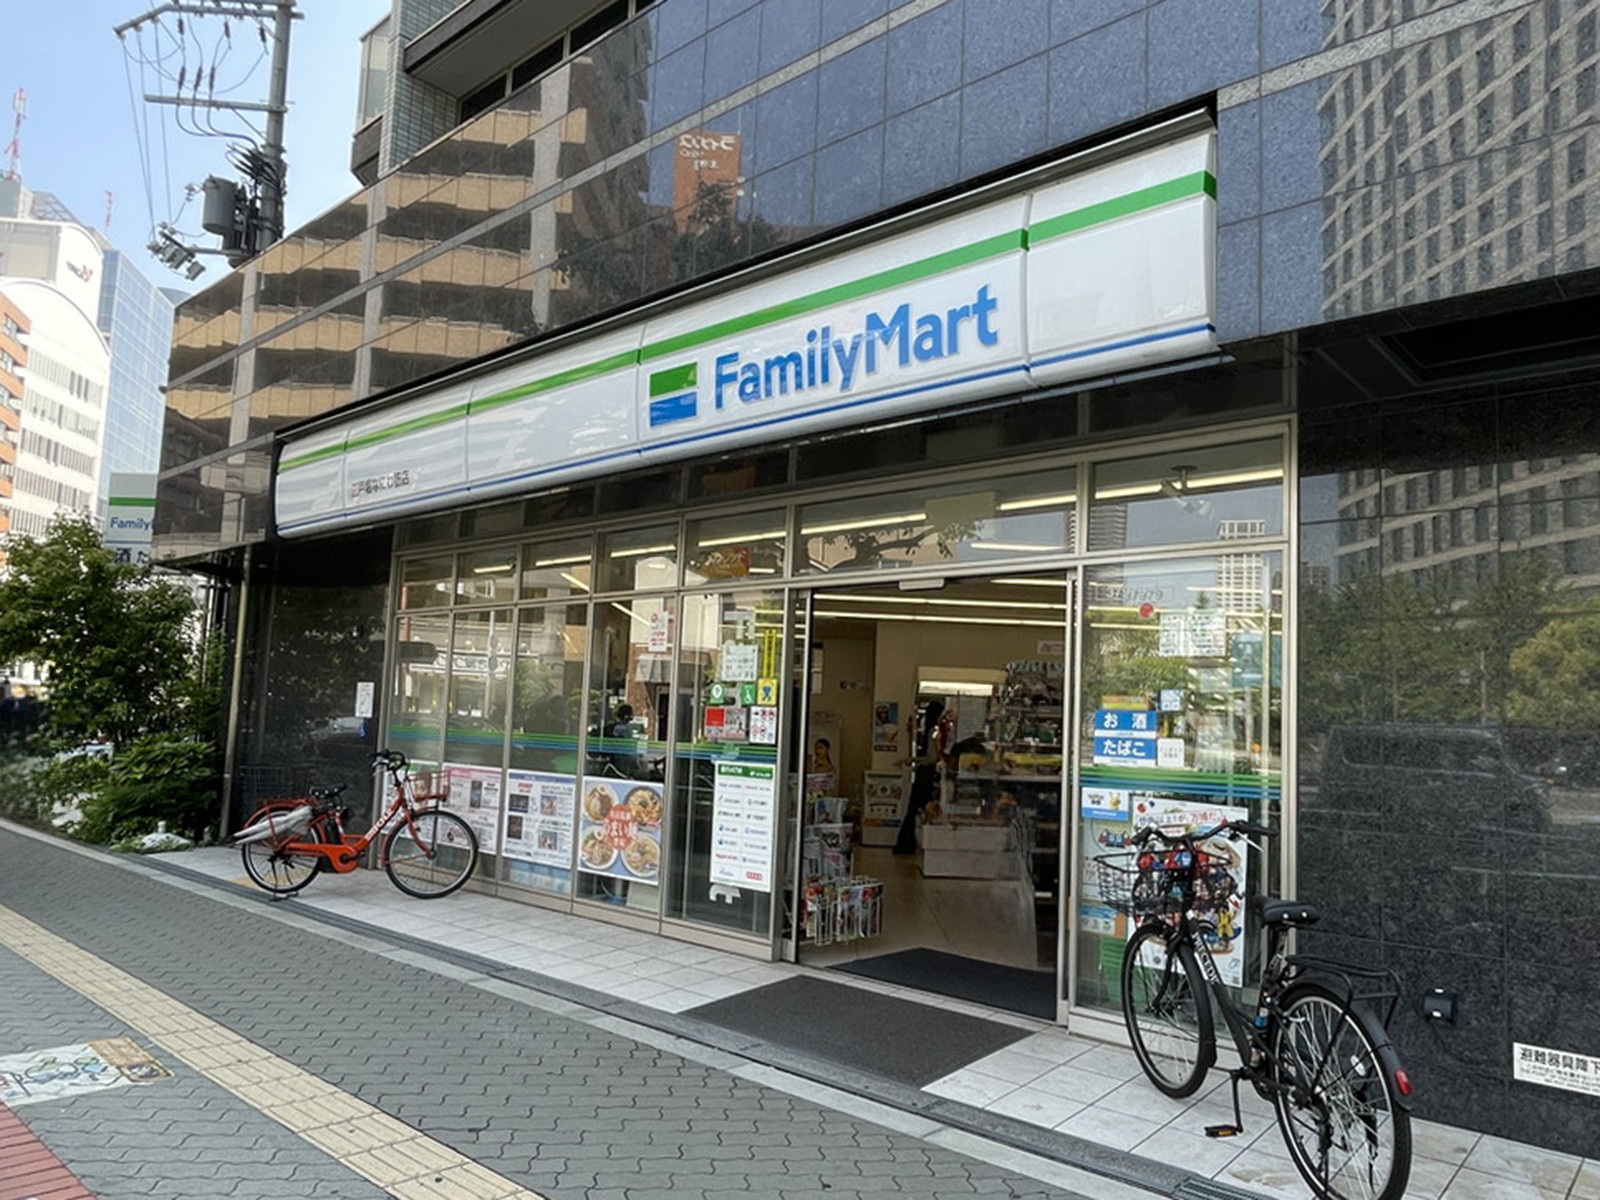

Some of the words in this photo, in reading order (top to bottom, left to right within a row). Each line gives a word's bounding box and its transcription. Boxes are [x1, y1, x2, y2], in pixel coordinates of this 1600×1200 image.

[714, 283, 998, 410] FamilyMart
[110, 516, 152, 531] Family
[1103, 712, 1147, 730] お酒
[1102, 738, 1147, 757] たばこ
